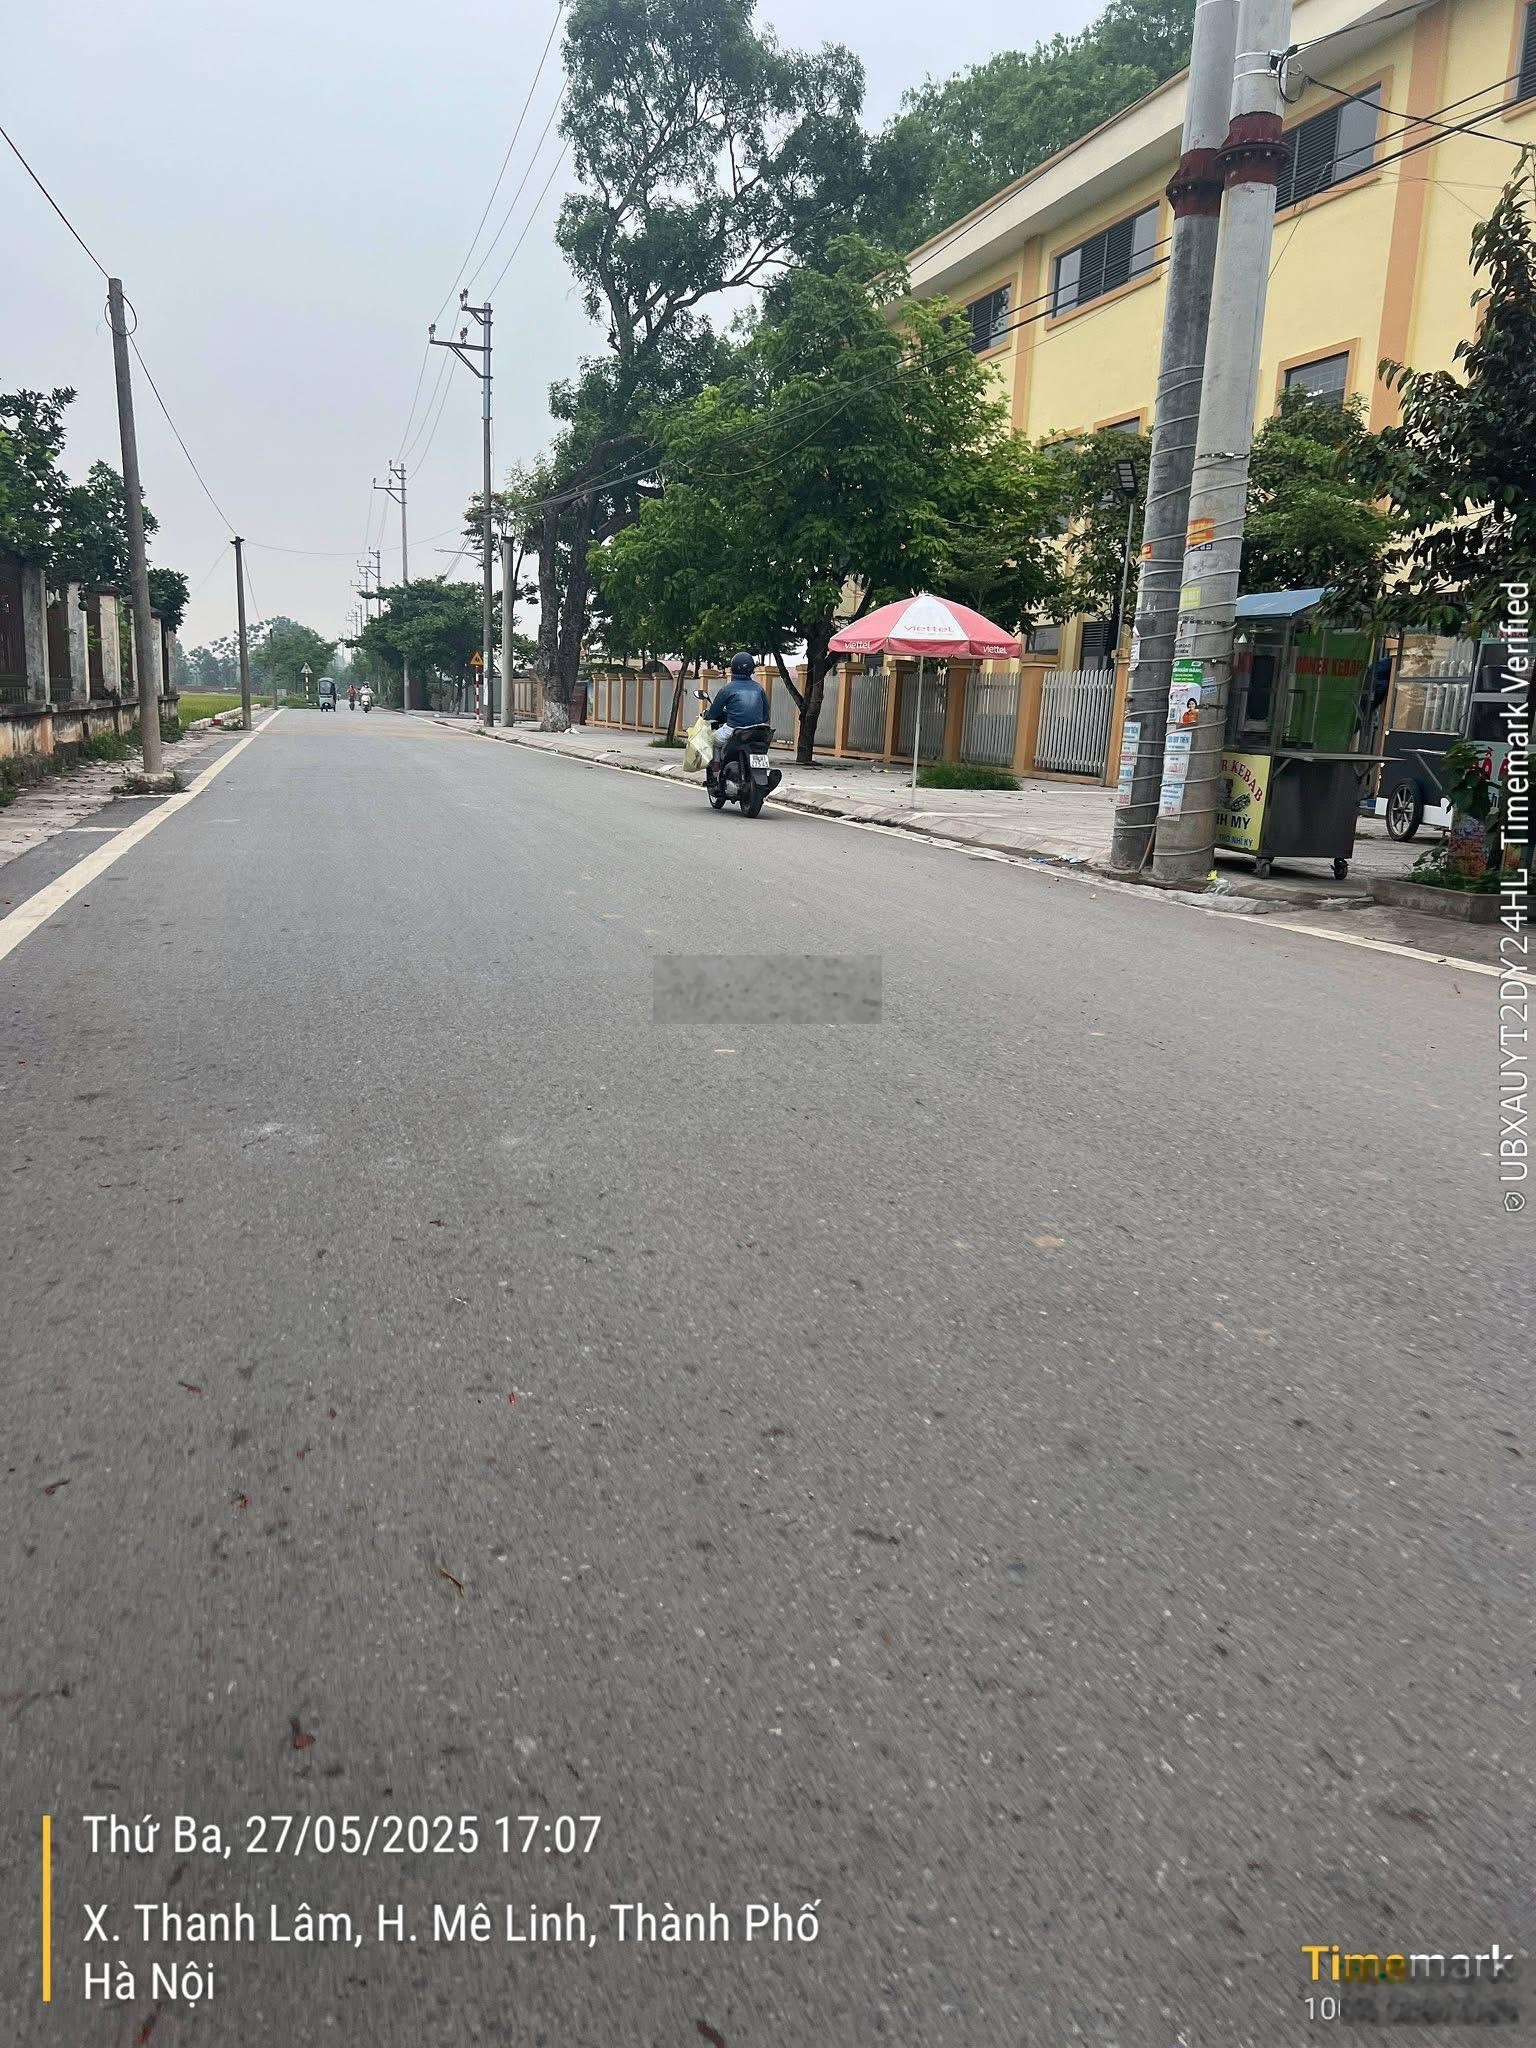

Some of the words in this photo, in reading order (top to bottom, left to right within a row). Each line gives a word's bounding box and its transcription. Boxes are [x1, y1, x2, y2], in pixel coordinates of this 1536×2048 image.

[904, 625, 955, 633] viettel
[844, 641, 871, 650] viettel
[982, 645, 1008, 655] viettel
[1231, 758, 1264, 803] KEBAB
[1230, 813, 1252, 830] MỲ
